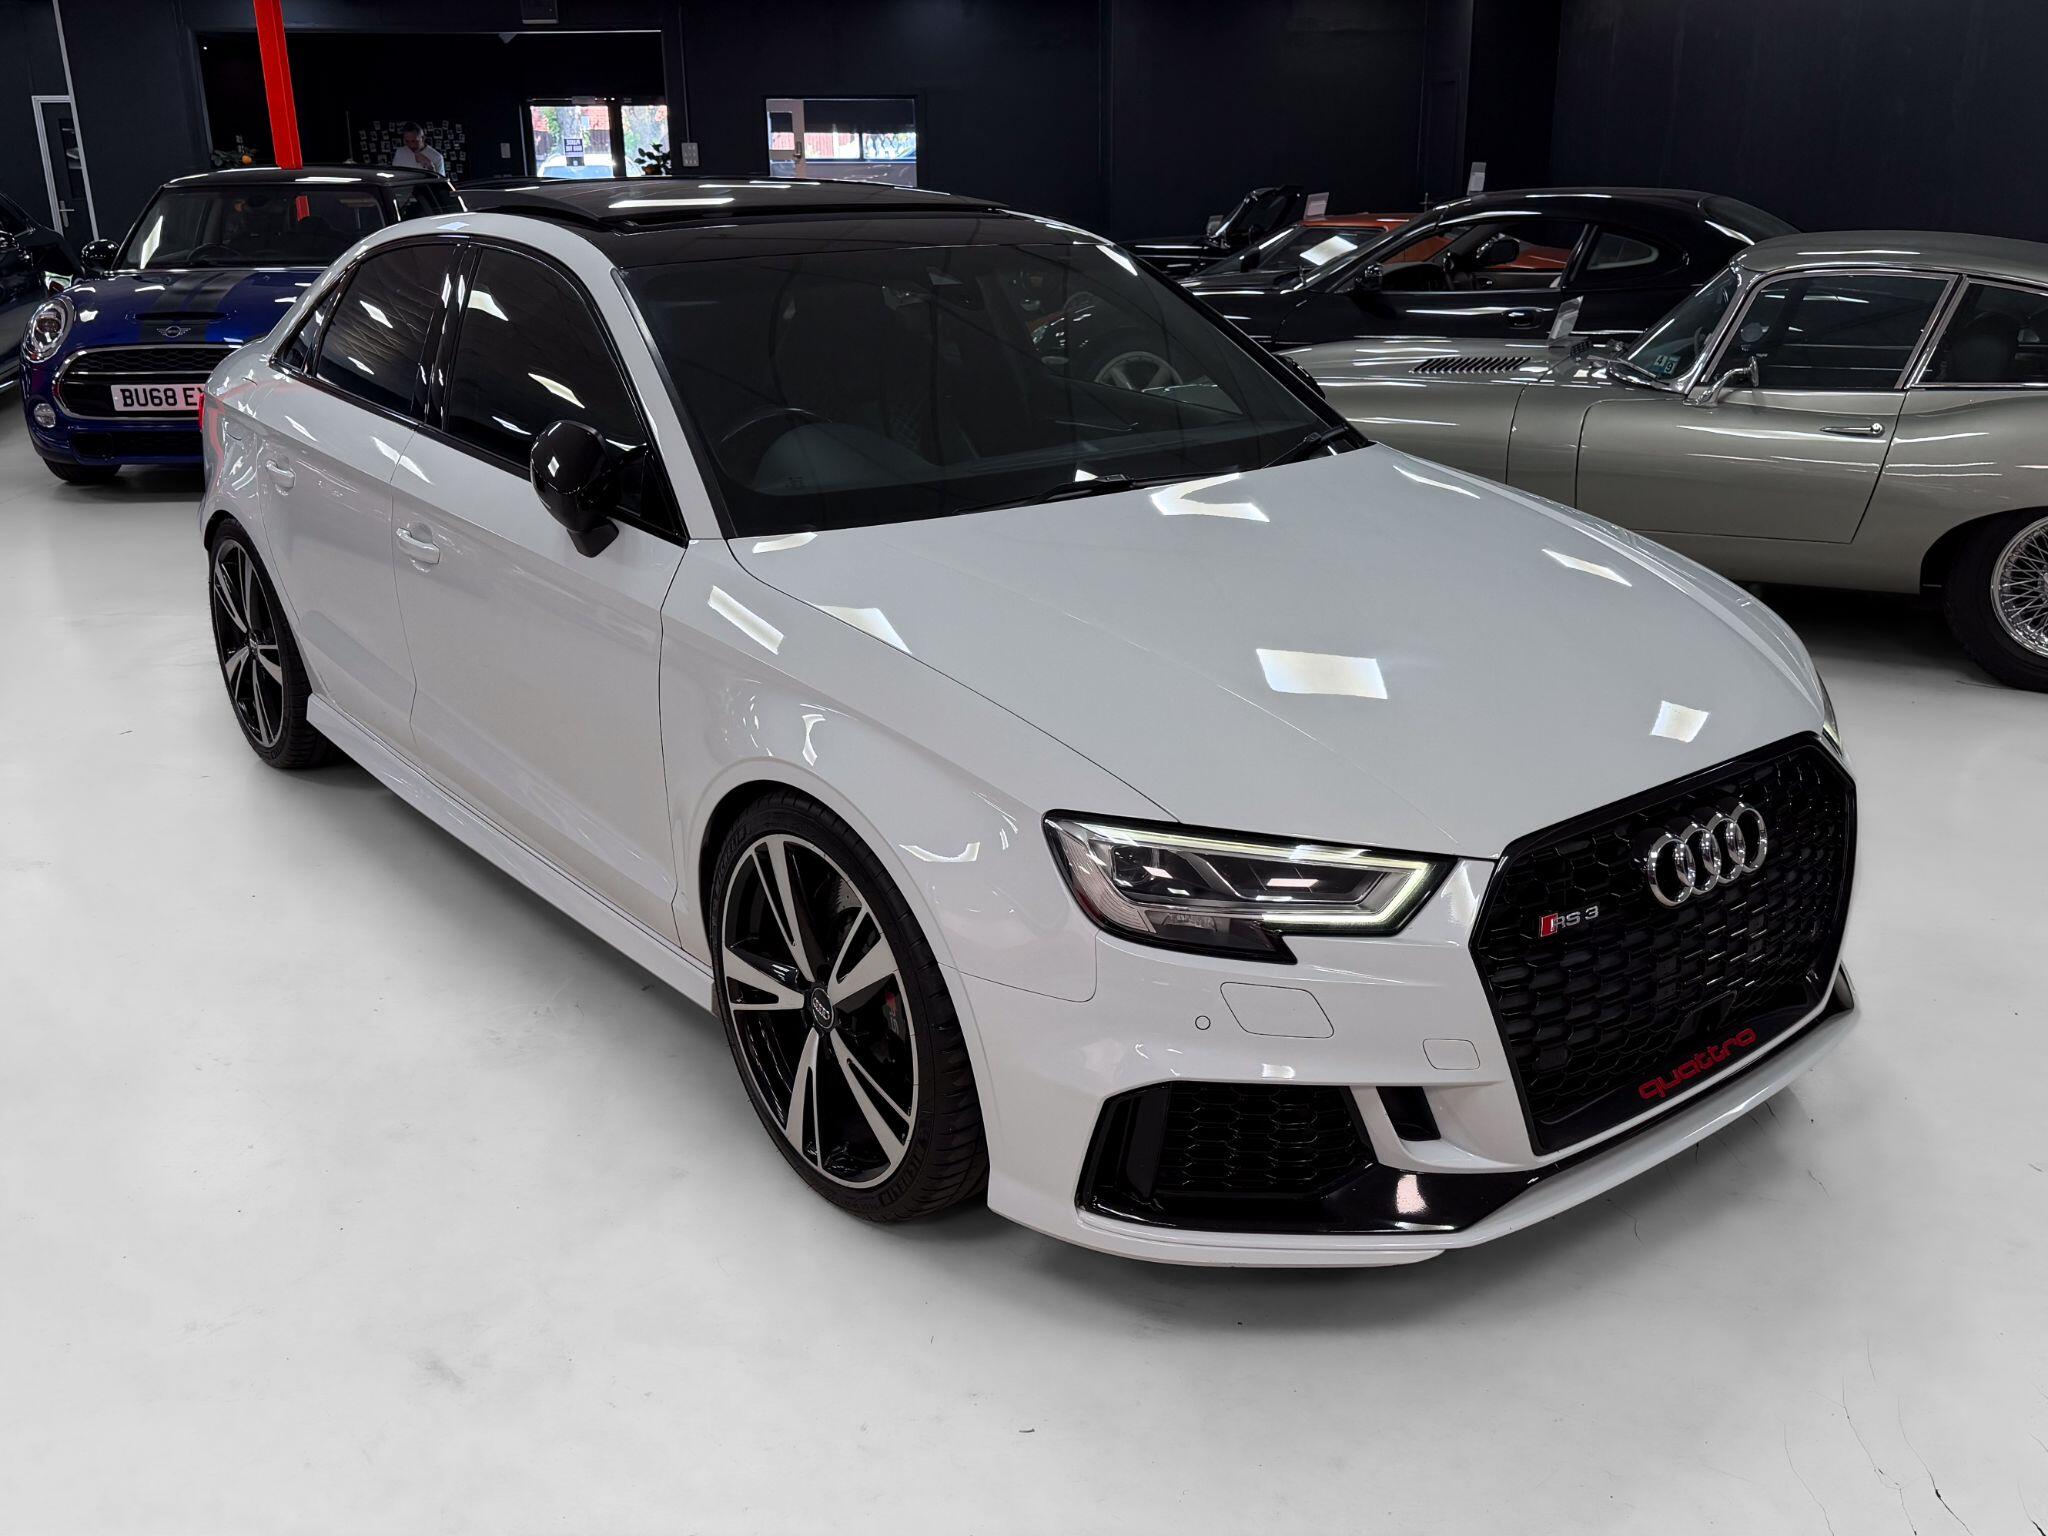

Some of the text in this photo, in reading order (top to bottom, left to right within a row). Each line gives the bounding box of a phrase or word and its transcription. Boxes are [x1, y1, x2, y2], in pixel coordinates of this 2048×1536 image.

[120, 387, 178, 407] BU68
[1585, 905, 1600, 920] 3
[1637, 1026, 1759, 1100] quattro
